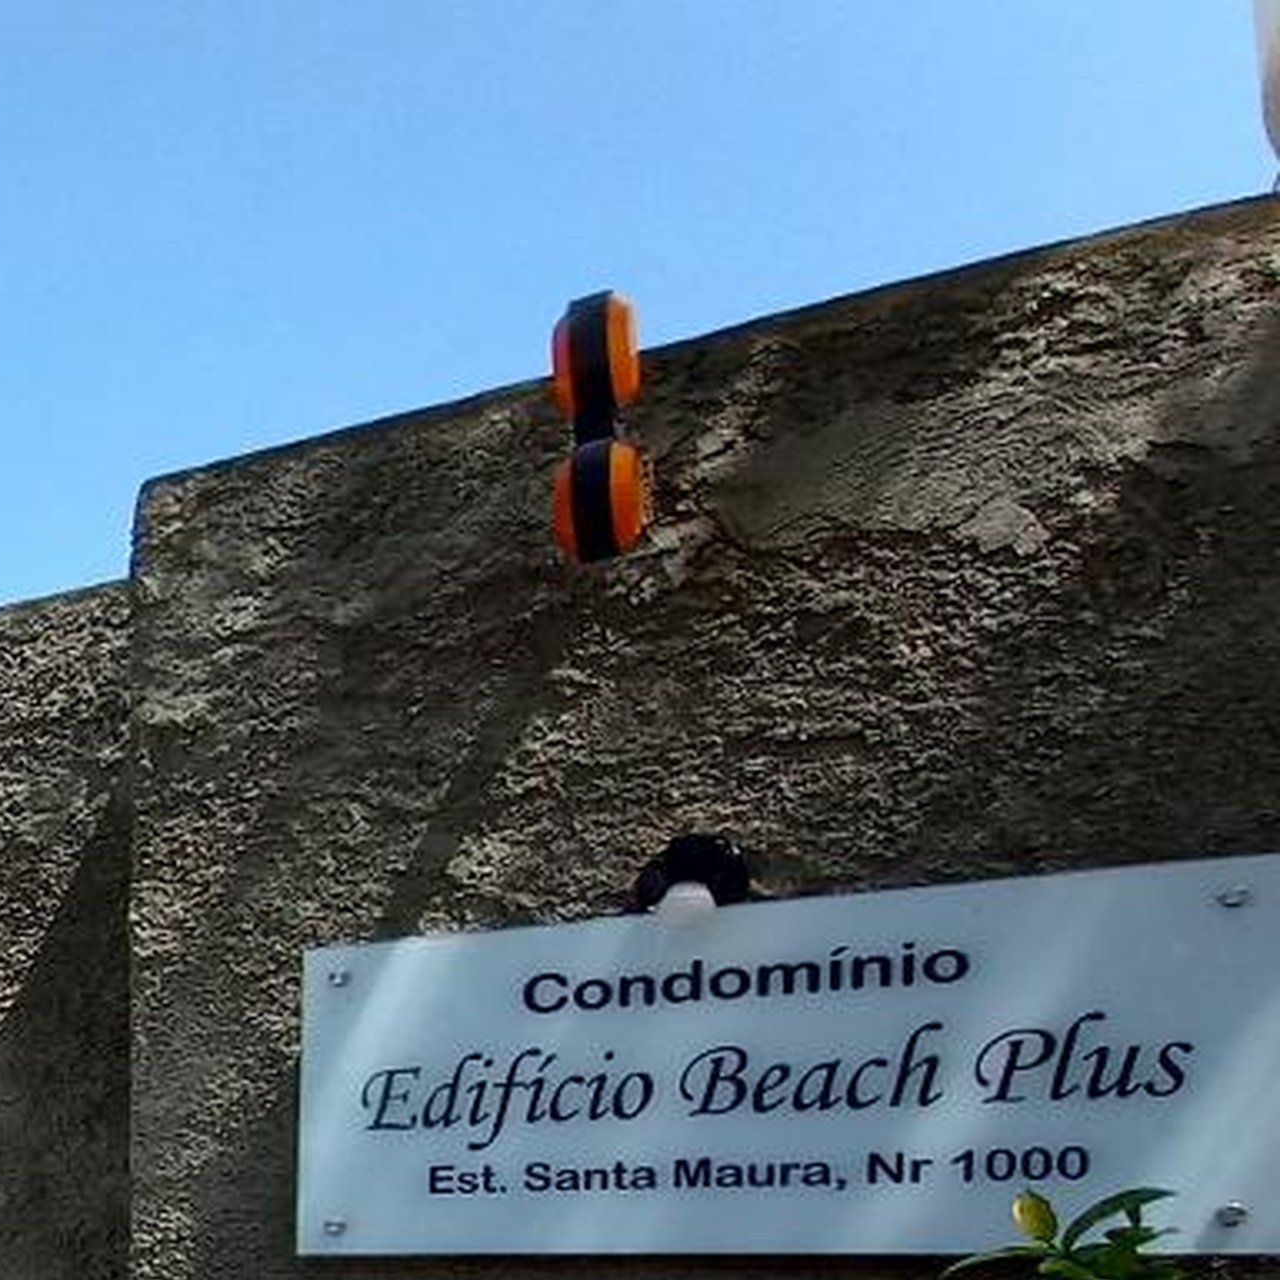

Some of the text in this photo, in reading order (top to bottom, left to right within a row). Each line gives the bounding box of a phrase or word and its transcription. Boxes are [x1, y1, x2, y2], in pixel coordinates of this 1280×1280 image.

[522, 942, 970, 1013] Condomínio
[362, 1012, 1195, 1151] Edifício Beach Plus
[428, 1146, 1090, 1195] Est. Santa Maura, Nr 1000
